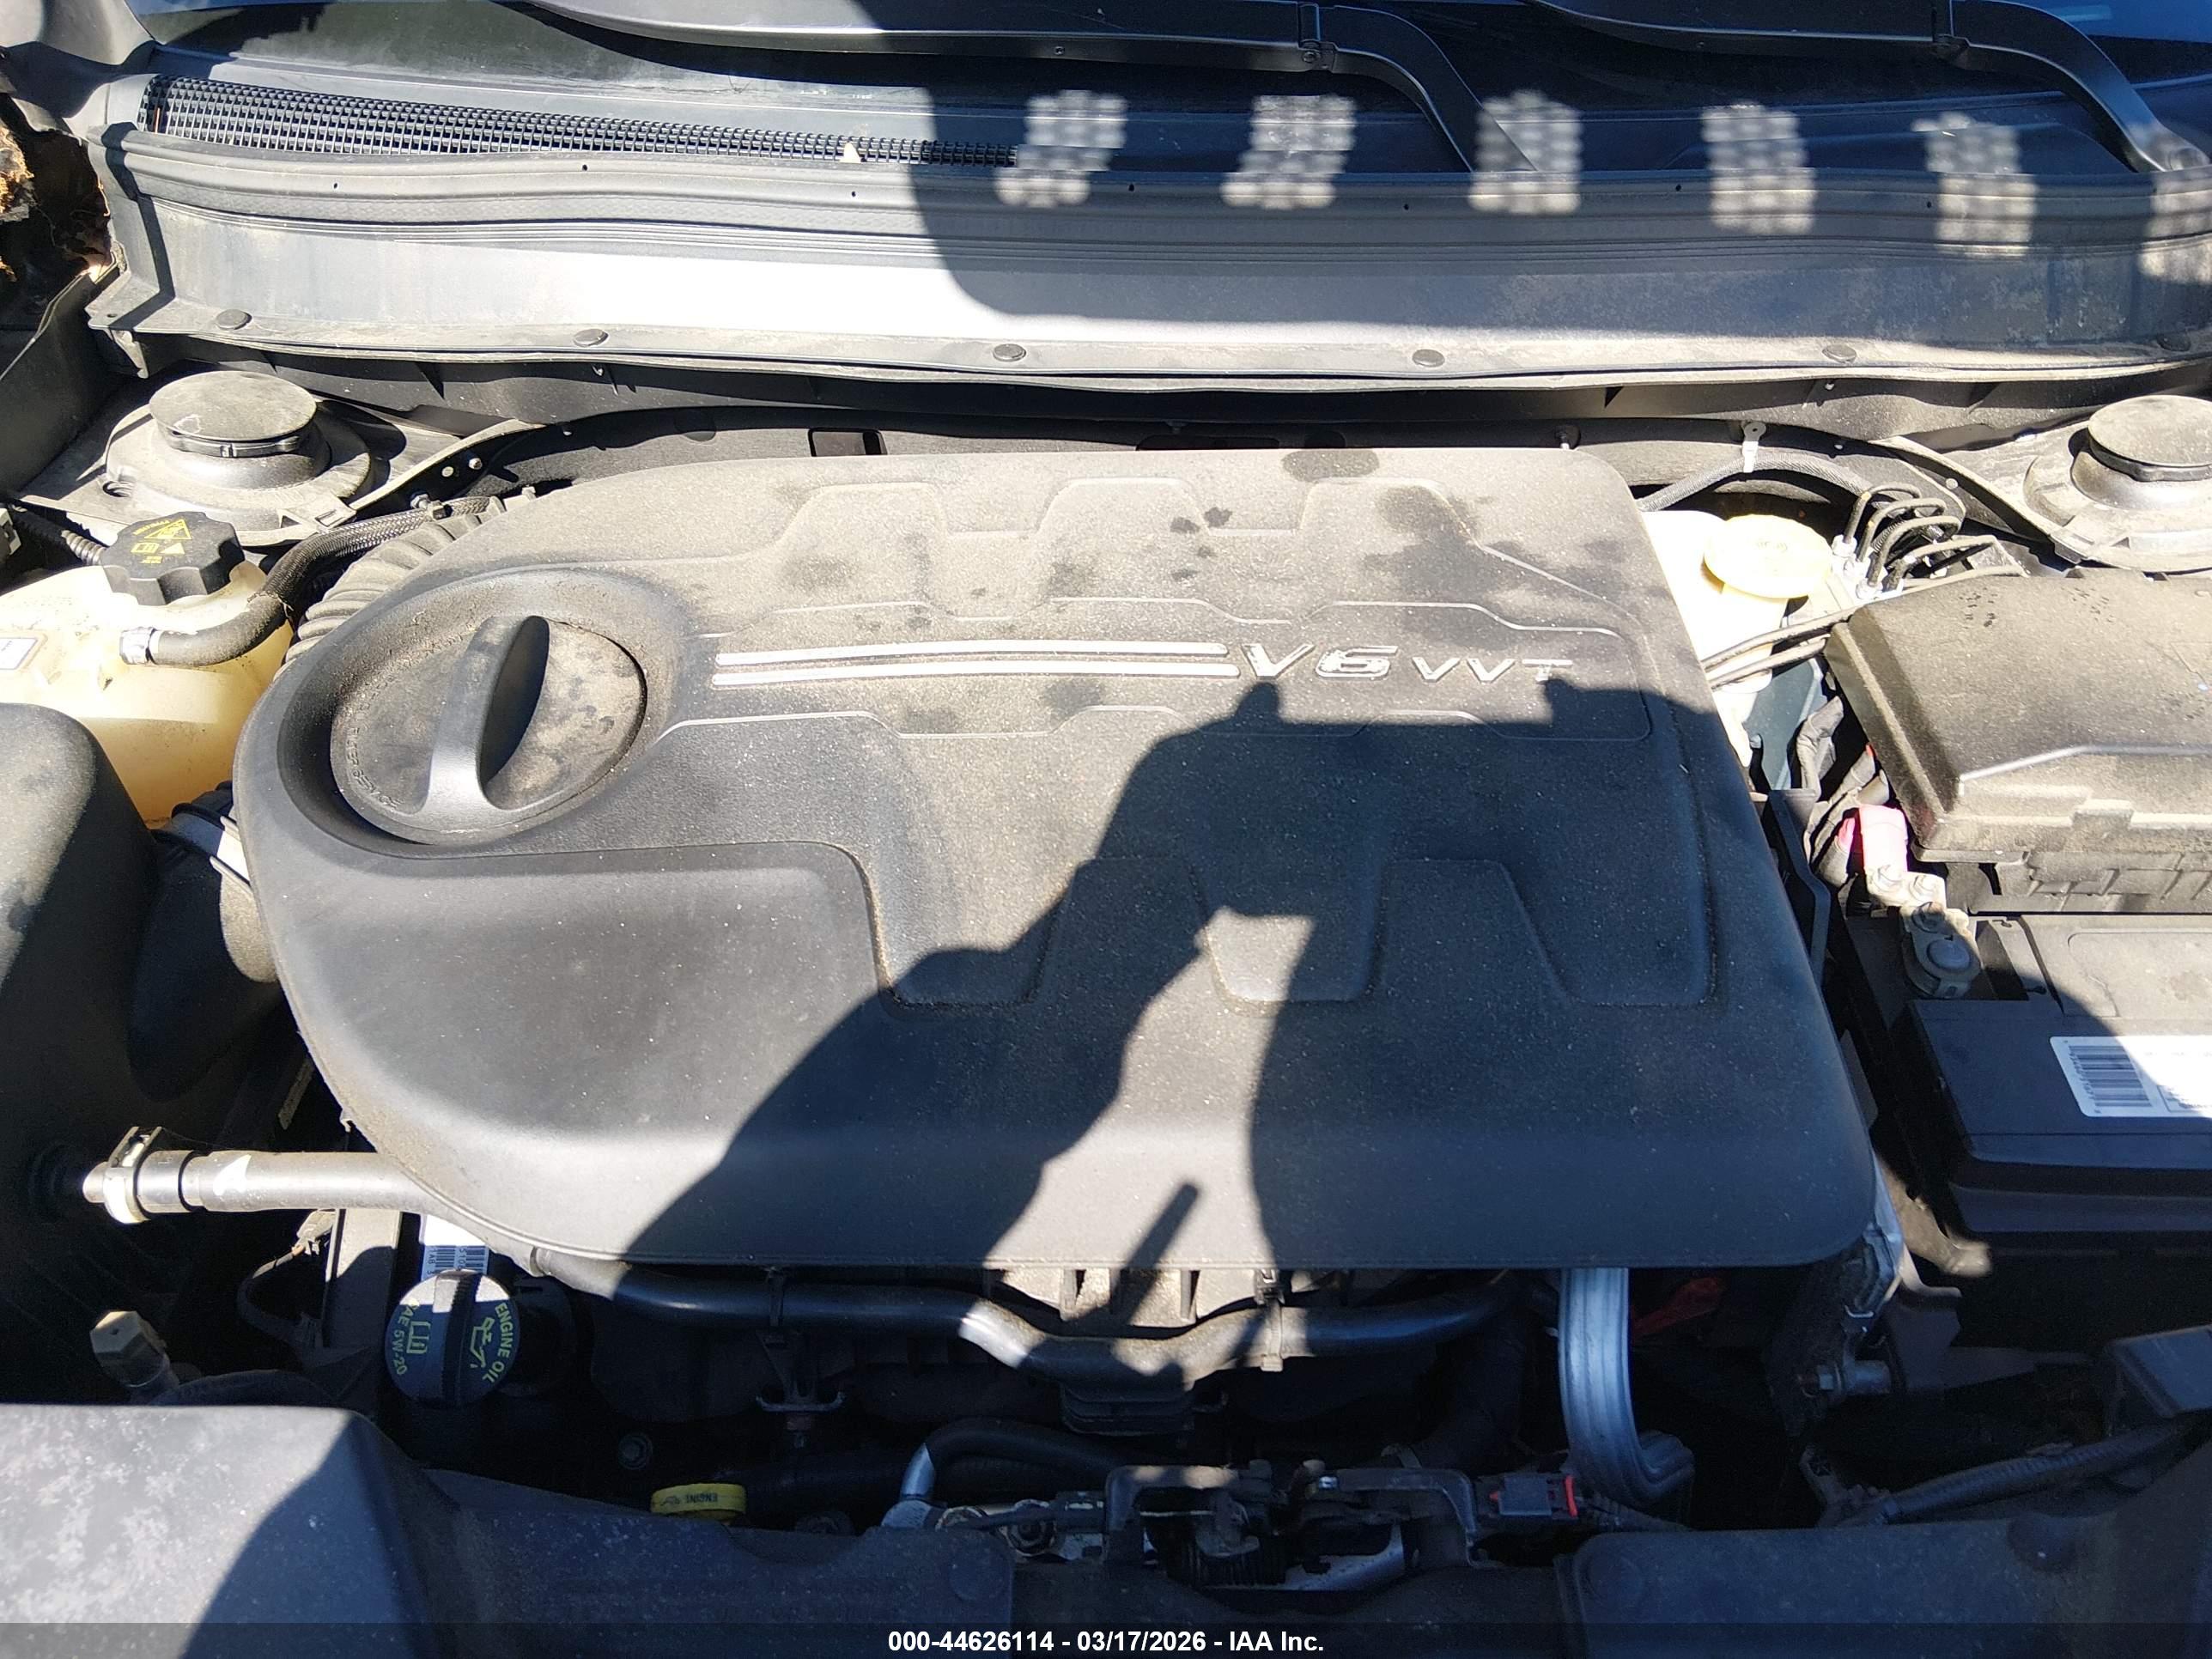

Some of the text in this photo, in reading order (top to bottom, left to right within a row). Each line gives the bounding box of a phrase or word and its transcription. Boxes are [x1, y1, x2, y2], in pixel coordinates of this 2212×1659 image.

[1241, 643, 1573, 684] V6 VVT
[392, 1330, 408, 1376] 5W-20
[482, 1302, 514, 1383] ENGINE OIL
